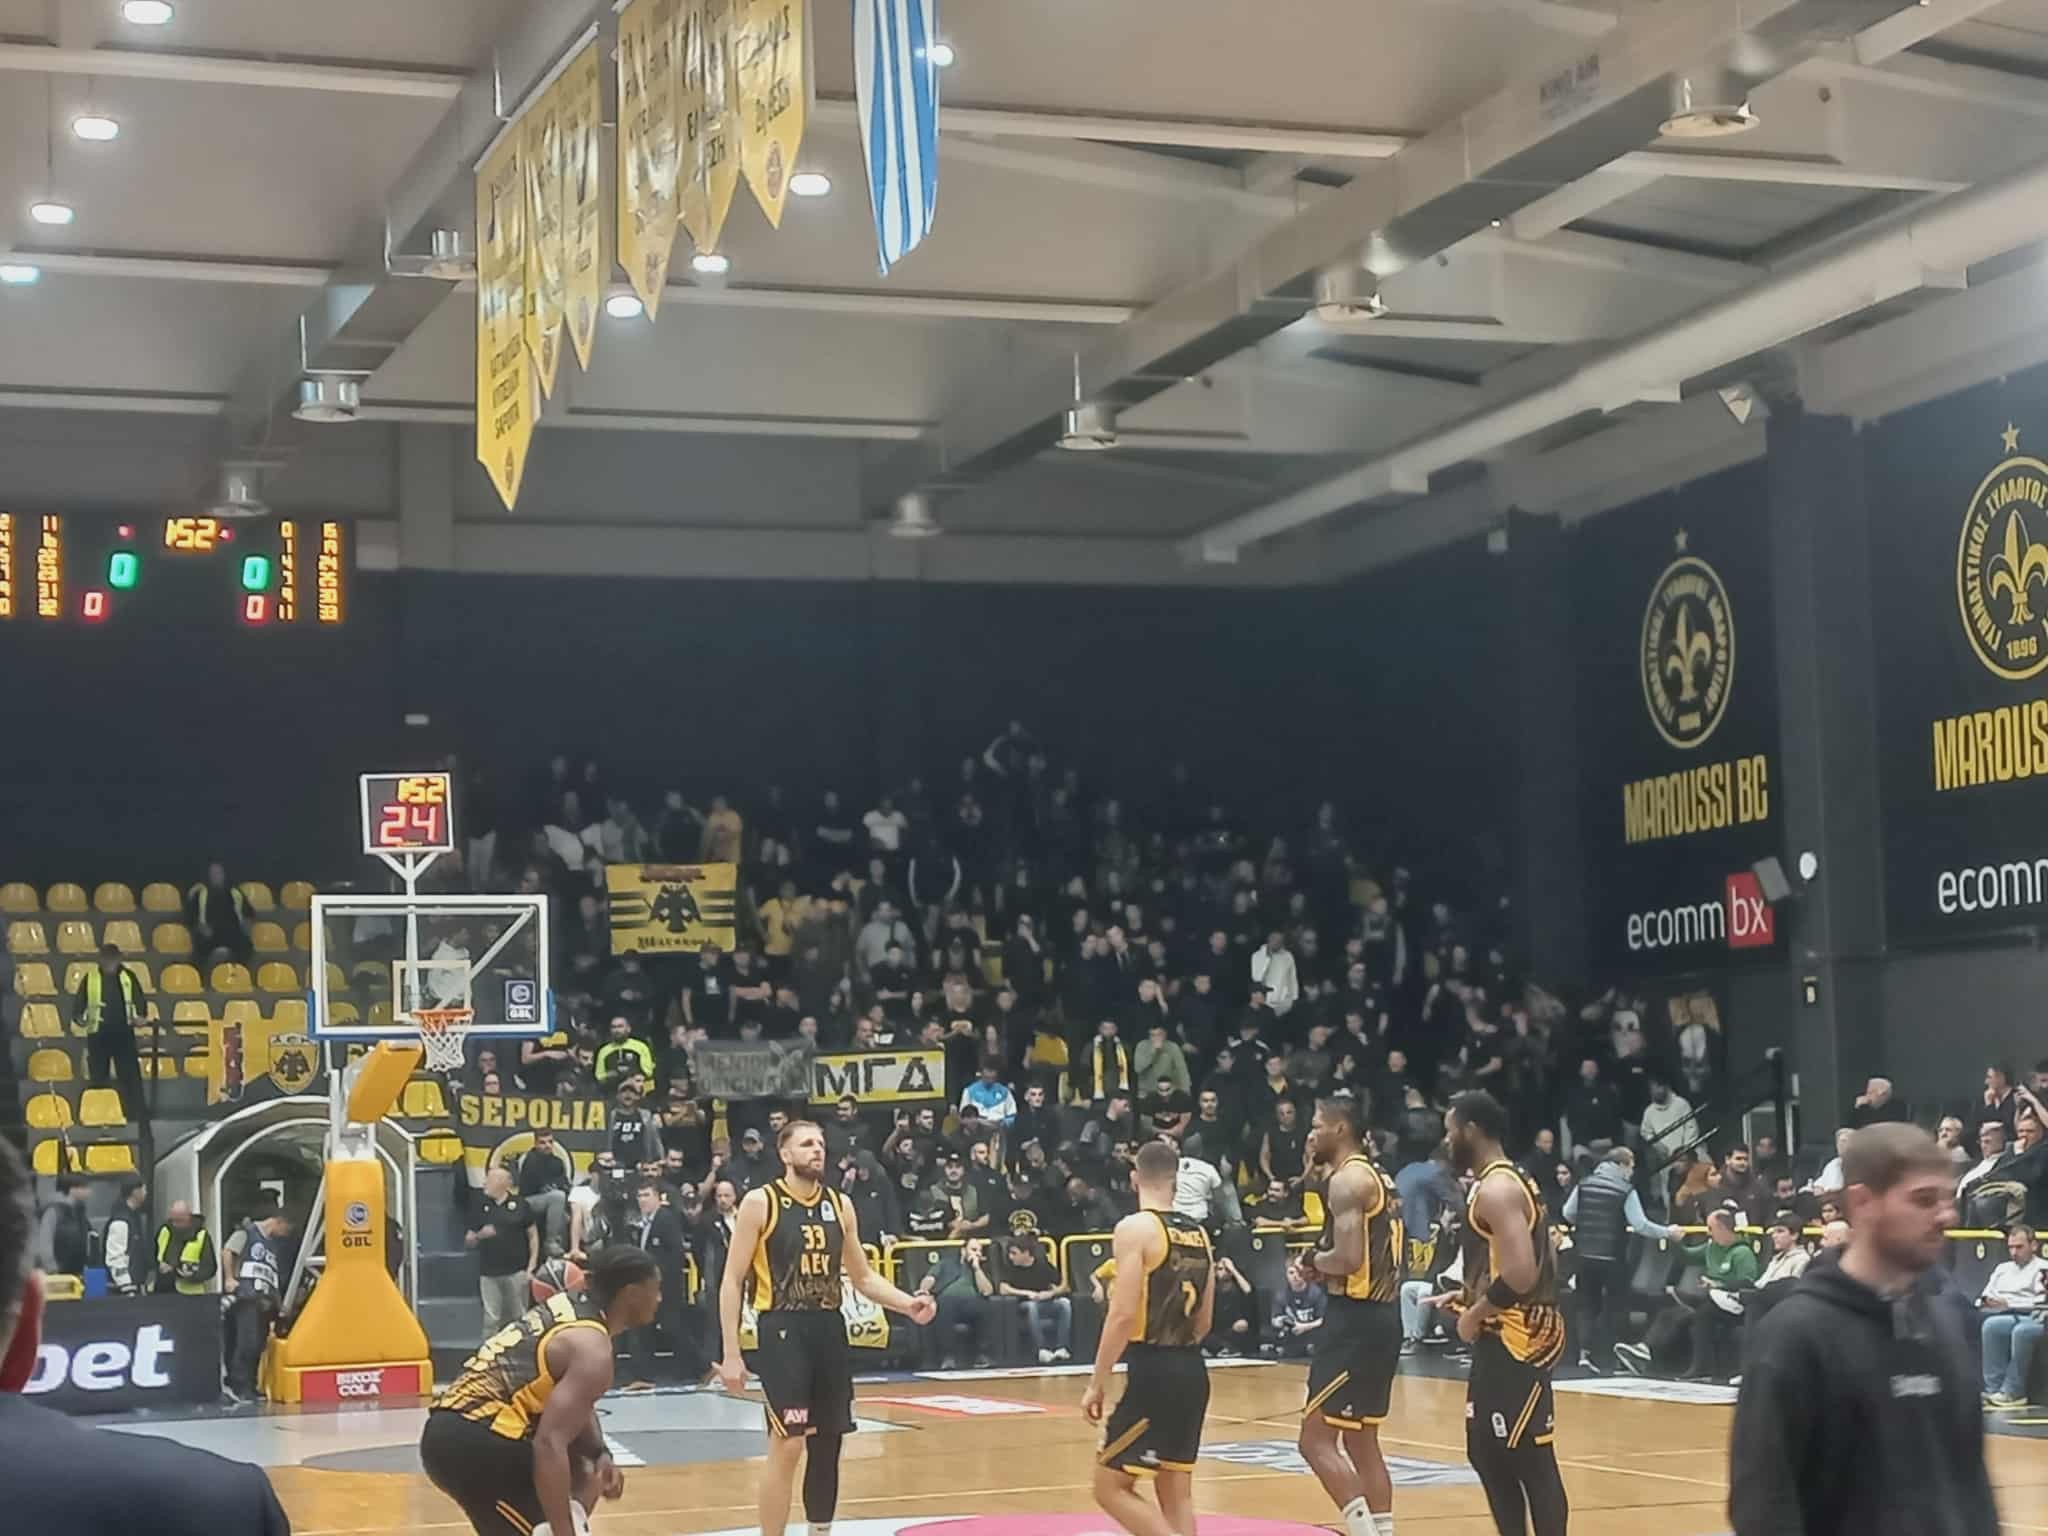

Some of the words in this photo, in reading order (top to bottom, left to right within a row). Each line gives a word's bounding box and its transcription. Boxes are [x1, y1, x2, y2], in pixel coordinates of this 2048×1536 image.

[110, 552, 138, 588] 0
[243, 556, 269, 590] 0
[84, 592, 103, 616] 0
[246, 595, 265, 620] 0
[1624, 761, 1733, 844] MAROUSSI
[1737, 755, 1768, 824] BC
[380, 805, 437, 844] 24
[460, 1094, 606, 1131] SEPOLIA
[800, 1225, 826, 1250] 33
